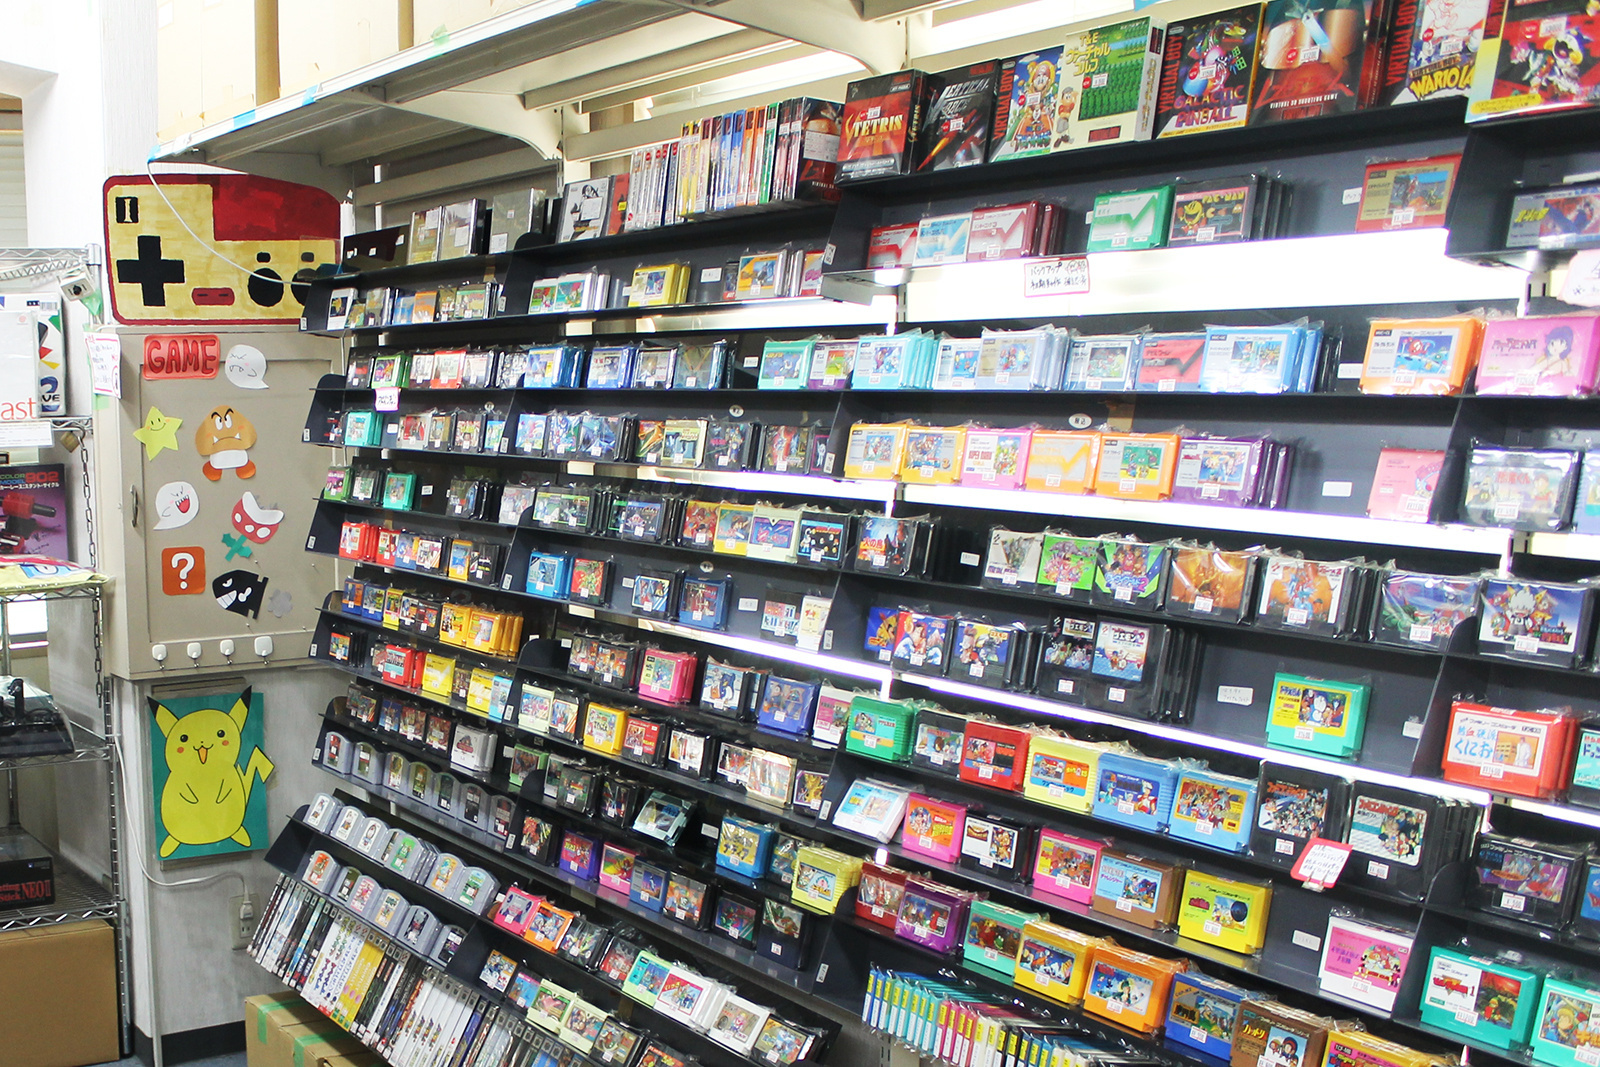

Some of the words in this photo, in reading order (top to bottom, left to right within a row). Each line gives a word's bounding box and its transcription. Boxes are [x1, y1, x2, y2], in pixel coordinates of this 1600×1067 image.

[1080, 32, 1099, 47] T&E
[1165, 36, 1183, 61] BOY
[1385, 25, 1414, 86] VIRTUAL
[1000, 69, 1015, 92] BOY
[1158, 60, 1180, 114] VIRTUAL
[1409, 66, 1460, 100] WARIO
[1174, 85, 1245, 109] GALACTIC
[852, 114, 904, 138] TETRIS
[993, 92, 1012, 140] VIRTUAL
[1175, 104, 1238, 128] PINBALL
[1202, 191, 1245, 204] PAC-MAN
[147, 338, 217, 375] GAME
[863, 536, 884, 549] 火の鳥
